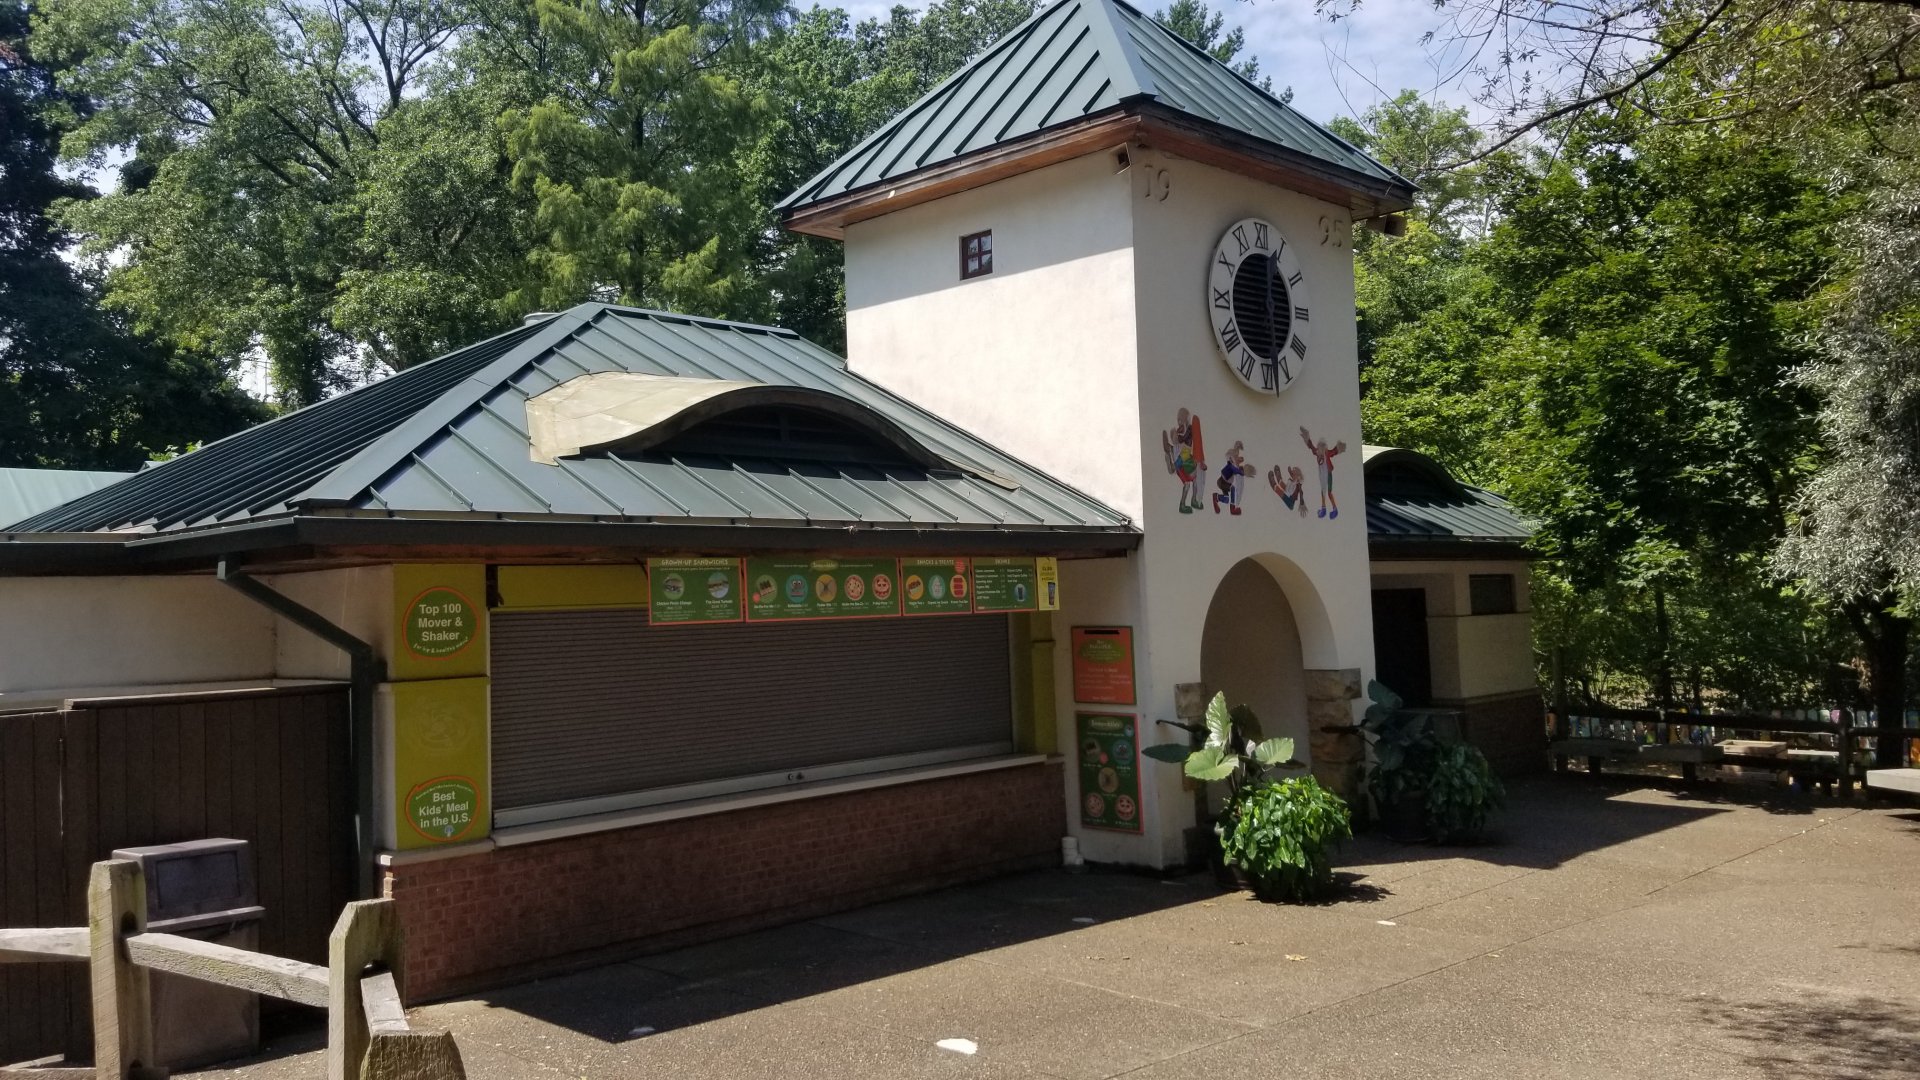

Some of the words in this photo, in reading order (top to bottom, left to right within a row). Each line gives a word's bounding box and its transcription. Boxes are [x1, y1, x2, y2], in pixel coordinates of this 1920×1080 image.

[1144, 164, 1170, 202] 19
[1232, 225, 1249, 256] XI
[1254, 222, 1268, 250] XII
[1318, 215, 1344, 247] 95
[1277, 237, 1286, 263] I
[1218, 251, 1235, 278] X
[1288, 271, 1303, 289] II
[1214, 287, 1230, 310] IX
[1295, 306, 1309, 321] III
[1219, 317, 1240, 353] VIII
[1237, 348, 1255, 381] VII
[1261, 363, 1273, 390] VI
[1279, 356, 1293, 384] V
[418, 617, 452, 628] Mover
[455, 616, 463, 627] &
[419, 604, 440, 616] Top
[442, 603, 462, 614] 100
[421, 630, 460, 641] Shaker
[419, 804, 443, 816] Kids'
[446, 800, 469, 813] Meal
[432, 790, 456, 802] Best
[420, 818, 429, 828] in
[432, 816, 449, 827] the
[451, 812, 471, 824] U.S.
